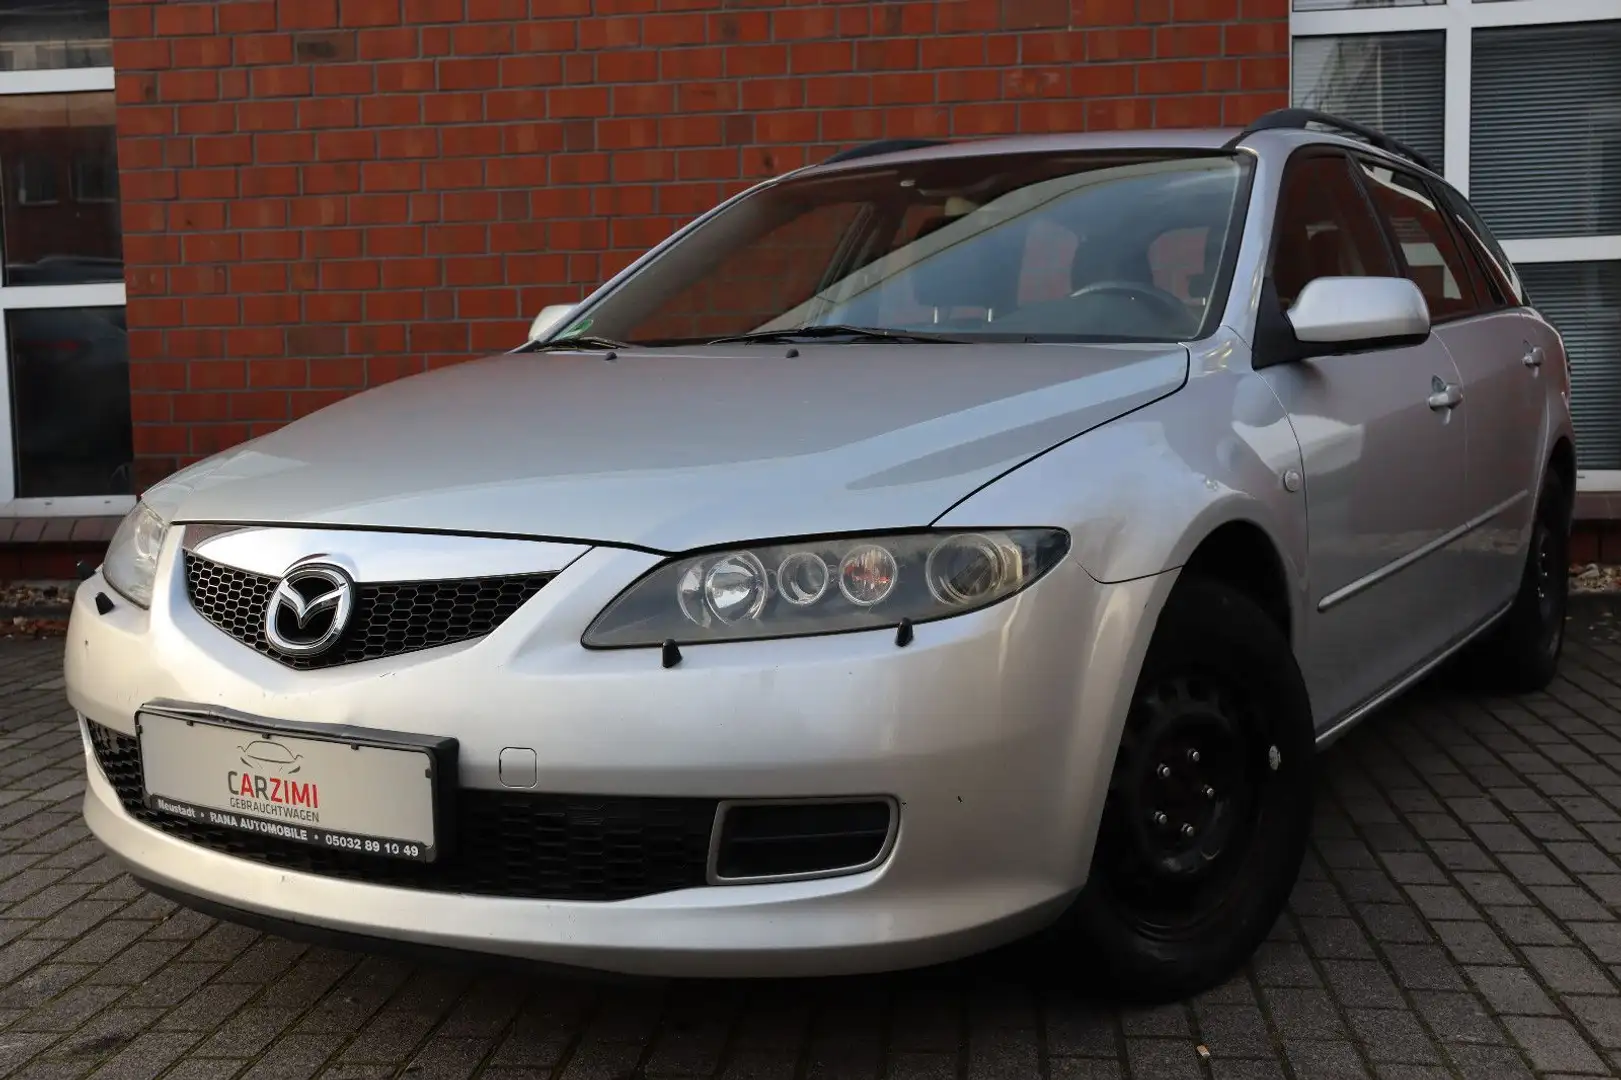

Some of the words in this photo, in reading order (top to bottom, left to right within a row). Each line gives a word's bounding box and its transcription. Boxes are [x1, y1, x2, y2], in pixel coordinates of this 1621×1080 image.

[228, 771, 318, 808] CARZIMI
[157, 799, 196, 818] Neustadt
[210, 812, 238, 827] RANA
[240, 818, 308, 840] AUTOMOBILE
[325, 834, 361, 850] 05032
[365, 840, 380, 852] 89
[384, 843, 400, 854] 10
[403, 845, 419, 856] 49
[230, 797, 319, 822] GEBRAUCHTWAGEN
